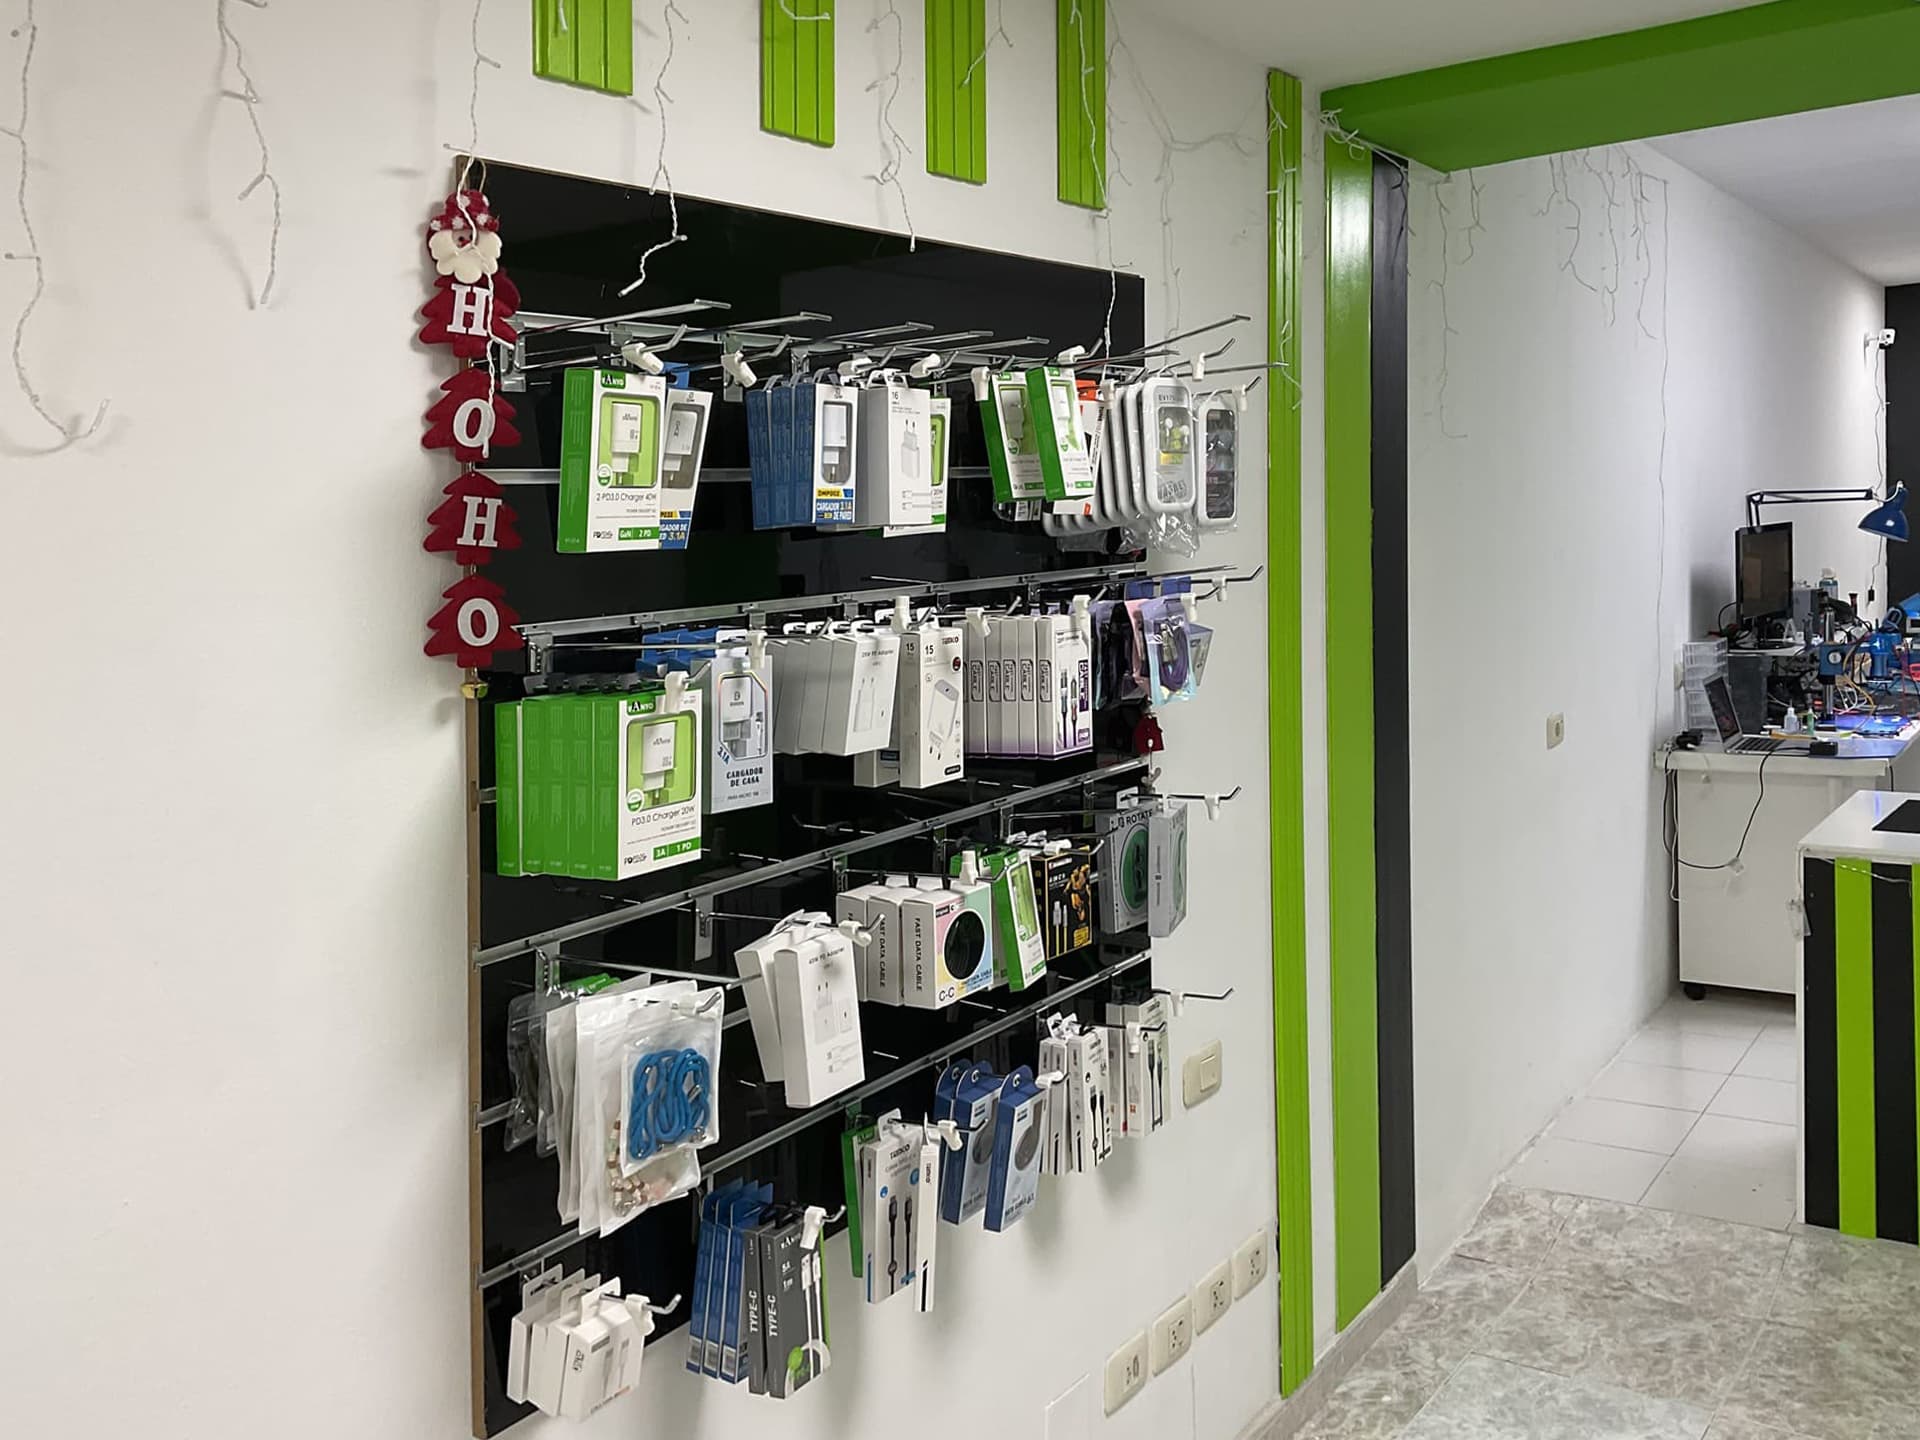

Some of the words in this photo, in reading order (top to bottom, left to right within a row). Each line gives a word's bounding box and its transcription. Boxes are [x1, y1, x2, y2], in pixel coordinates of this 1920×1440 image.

[447, 283, 489, 337] H
[453, 398, 496, 448] O
[621, 492, 645, 502] Charger
[457, 495, 502, 547] H
[457, 597, 500, 647] O
[906, 643, 915, 651] 15
[925, 645, 934, 655] 15
[726, 766, 763, 779] CARGADOR
[730, 778, 740, 787] DE
[742, 776, 760, 785] CASA
[631, 814, 651, 826] PD3.0
[653, 810, 680, 821] Charger
[681, 806, 695, 815] 20W
[1126, 809, 1153, 825] ROTATE
[681, 842, 692, 851] PD
[938, 986, 955, 1002] C-C
[749, 1290, 759, 1333] TYPE-C
[768, 1294, 778, 1337] TYPE-C
